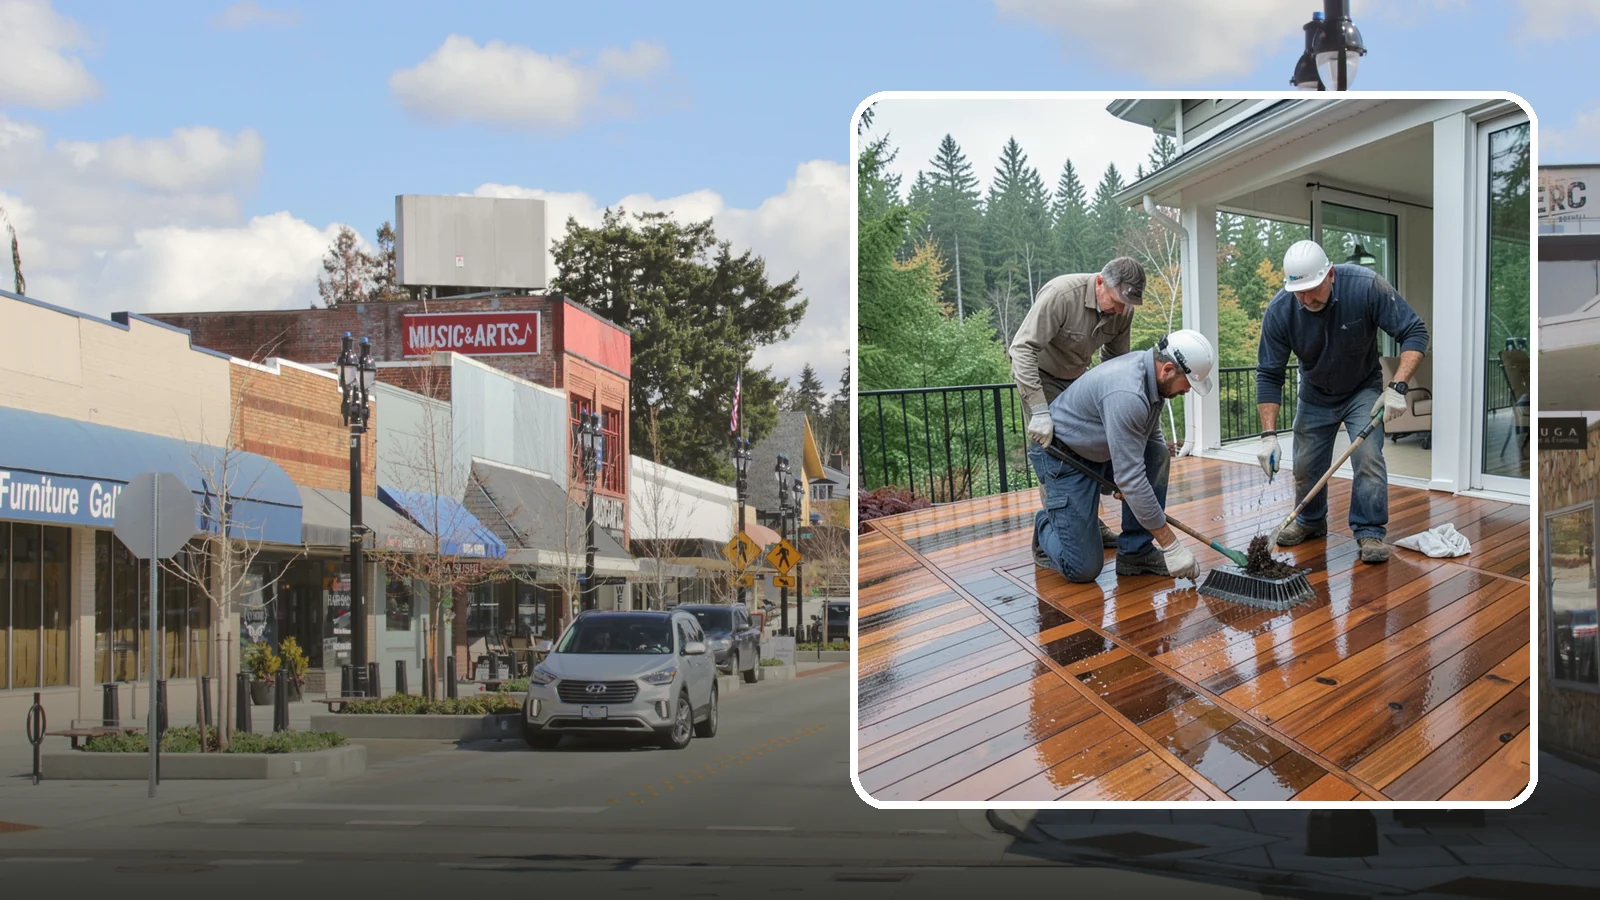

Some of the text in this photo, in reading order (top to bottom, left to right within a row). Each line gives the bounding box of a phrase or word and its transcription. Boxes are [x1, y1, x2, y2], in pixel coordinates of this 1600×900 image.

[409, 323, 520, 349] MUSIC&ARTS
[0, 472, 121, 518] Furniture Gal
